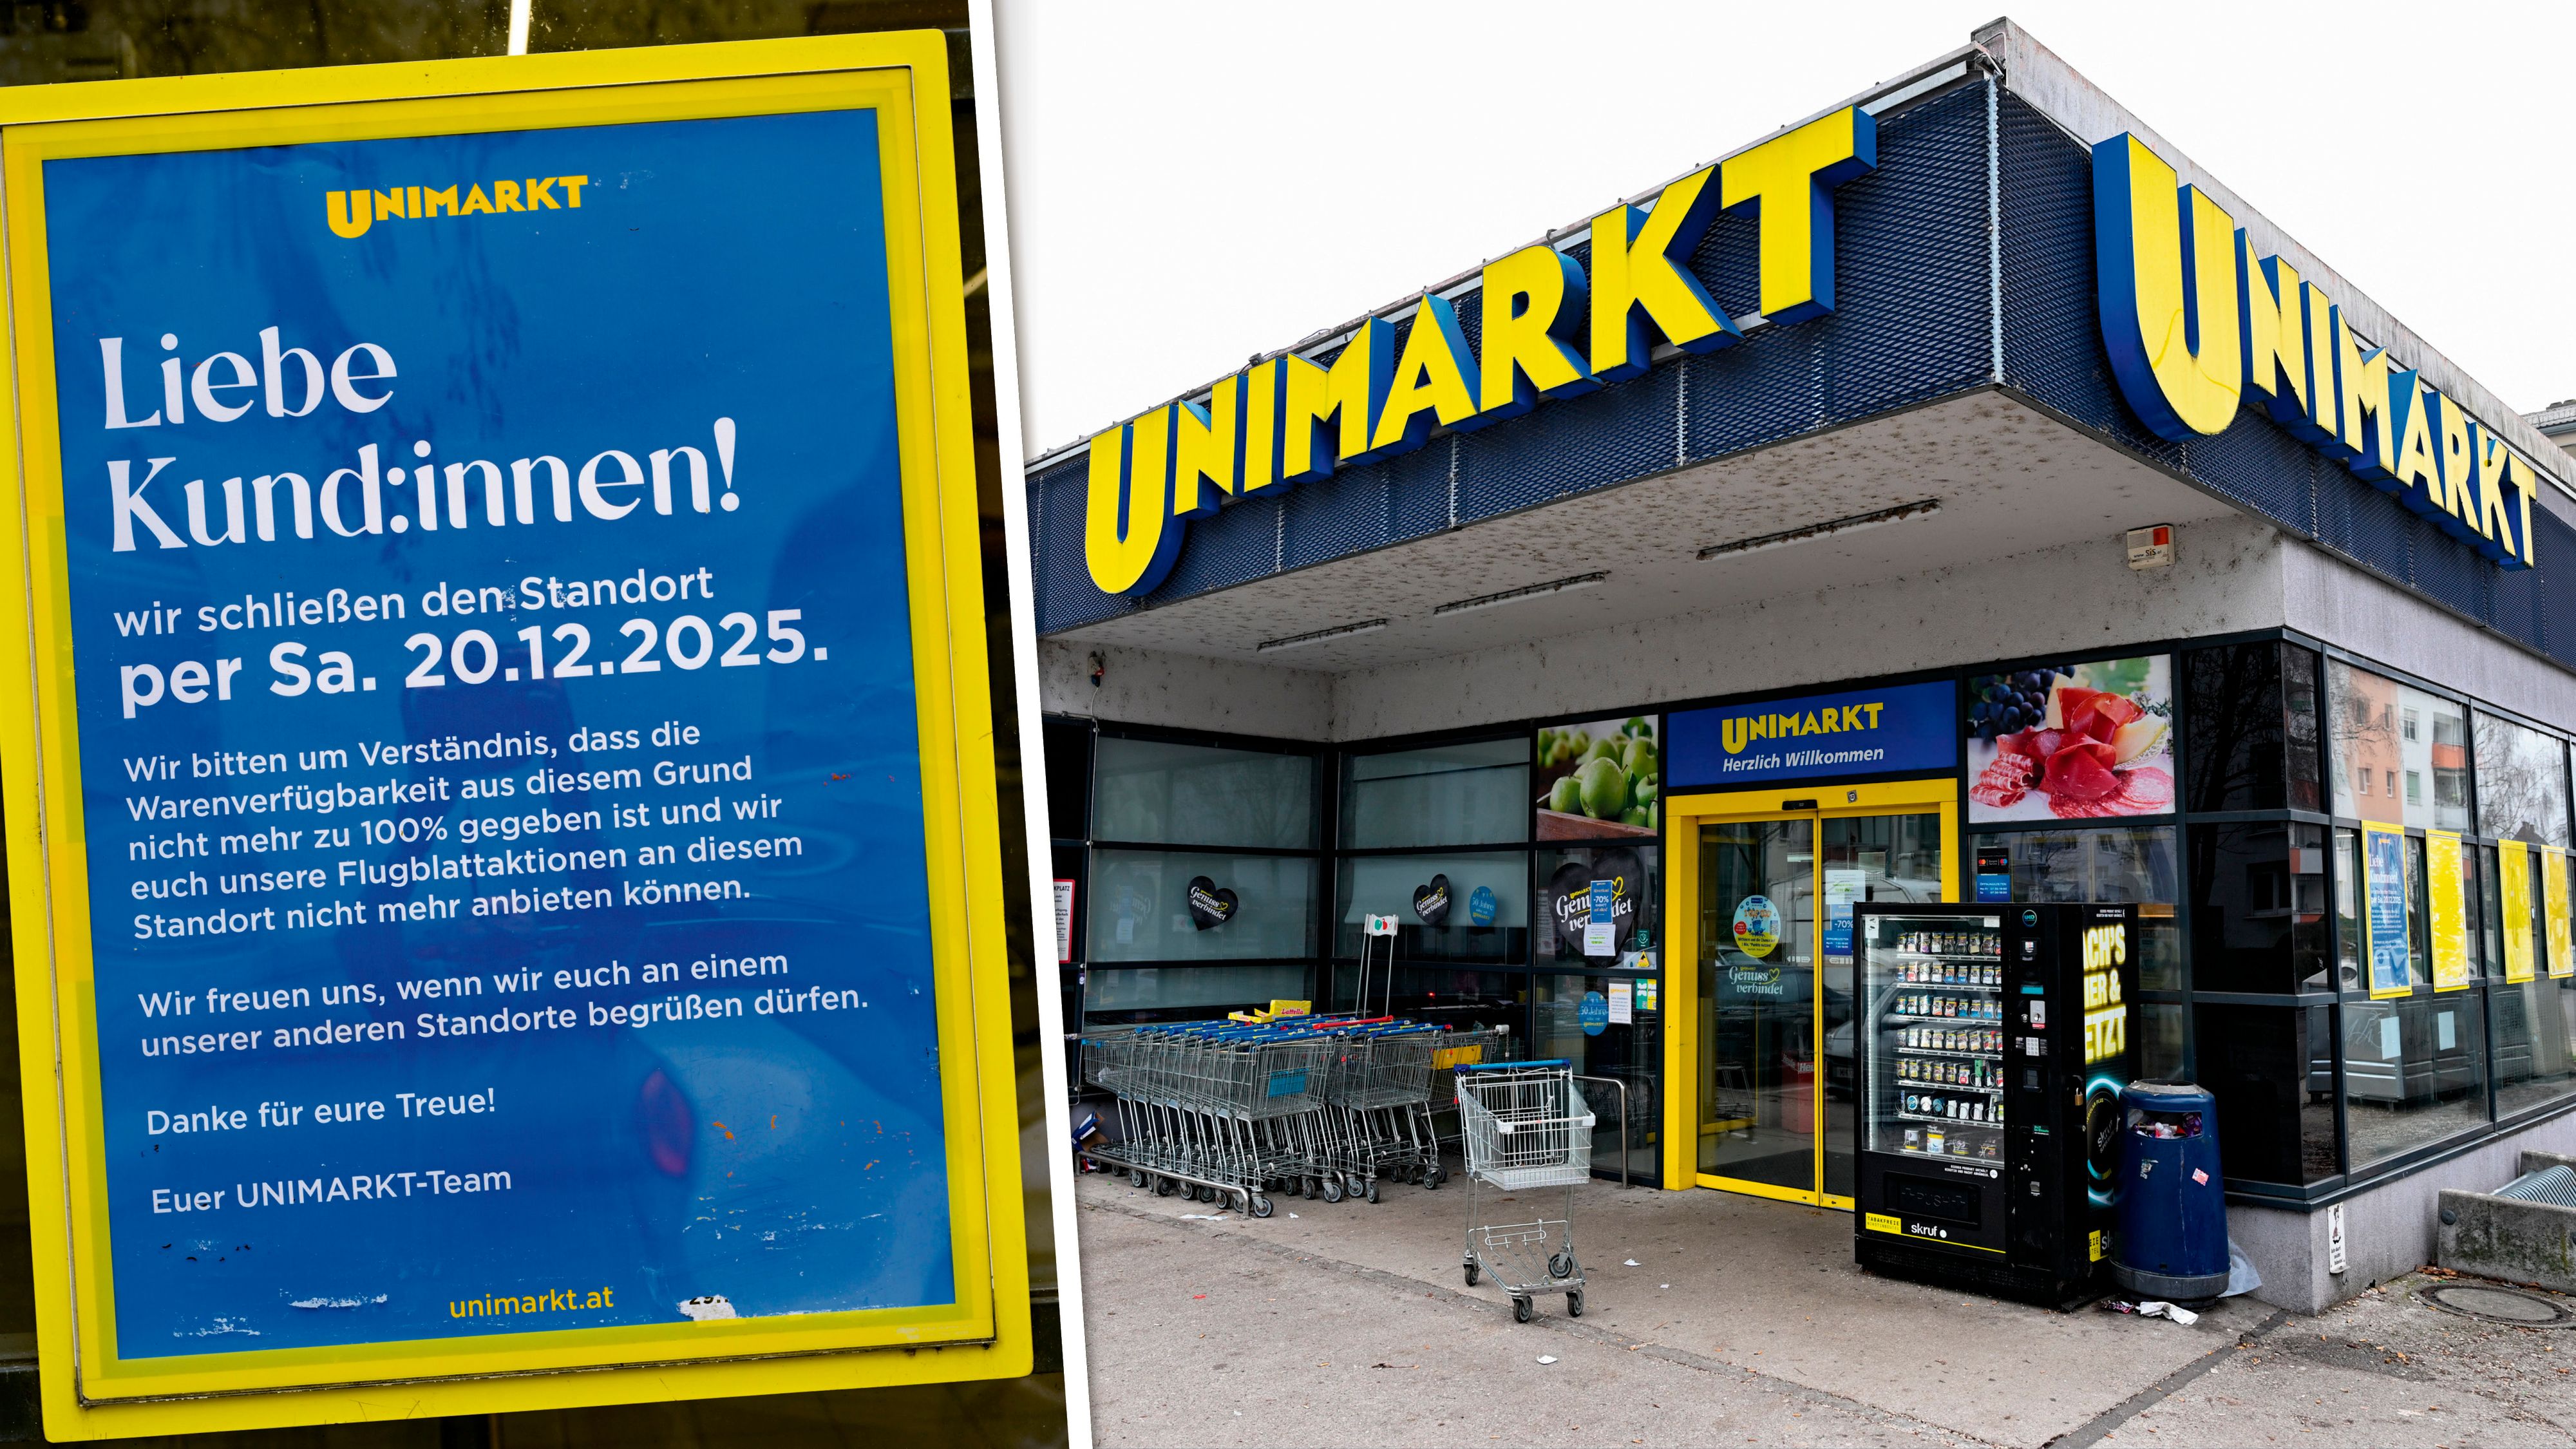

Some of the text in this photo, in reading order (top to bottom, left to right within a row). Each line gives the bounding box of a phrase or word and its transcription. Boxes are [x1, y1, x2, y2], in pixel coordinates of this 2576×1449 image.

[327, 175, 588, 238] UNIMARKT
[1085, 106, 1868, 594] UNIMARKT
[2109, 133, 2536, 567] UNIMARKT
[100, 327, 397, 429] Liebe
[108, 417, 739, 551] Kund:innen!
[113, 566, 714, 637] wir schließen den Standort
[121, 609, 827, 718] per Sa. 20.12.2025.
[124, 721, 699, 781] Wir bitten um Verständnis, dass die
[1722, 702, 1884, 754] UNIMARKT
[126, 755, 751, 820] Warenverfügbarkeit aus diesem Grund
[1723, 748, 1884, 772] Herzlich Willkommen
[130, 797, 781, 860] nicht mehr zu 100% gegeben ist und wir
[132, 837, 801, 899] euch unsere Flugblattaktionen an diesem
[135, 880, 749, 938] Standort nicht mehr anbieten können.
[1190, 886, 1220, 907] Genuss
[1192, 899, 1226, 920] verbindet
[1417, 893, 1438, 913] Genuss
[1422, 896, 1448, 916] verbindet
[138, 956, 787, 1017] Wir freuen uns, wenn wir euch an einem
[1729, 966, 1768, 985] Genuss
[1736, 982, 1783, 995] verbindet
[2109, 968, 2121, 1003] &
[142, 985, 867, 1056] unserer anderen Standorte begrüßen dürfen.
[148, 1088, 493, 1134] Danke für eure Treue!
[153, 1171, 511, 1213] Euer UNIMARKT-Team
[1868, 1216, 1900, 1226] TABAKFREIE
[1911, 1222, 1938, 1236] skruf
[449, 1285, 614, 1320] unimarkt.at
